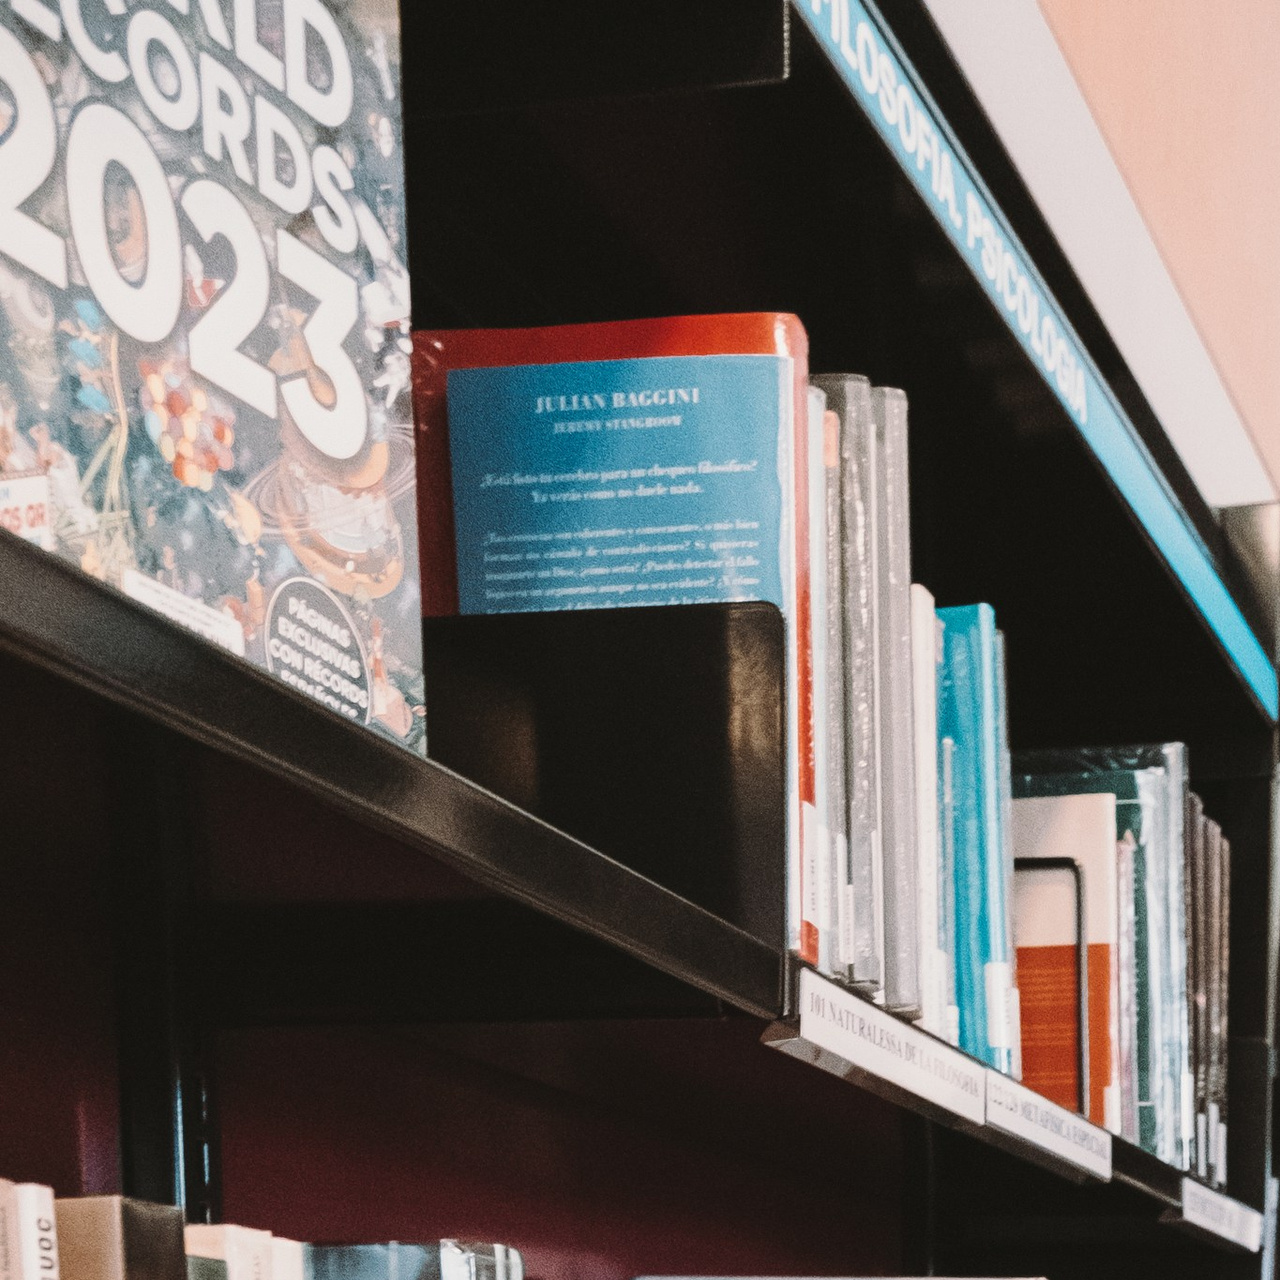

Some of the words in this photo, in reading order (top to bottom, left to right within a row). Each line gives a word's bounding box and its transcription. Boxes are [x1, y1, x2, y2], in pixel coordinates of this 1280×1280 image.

[0, 22, 367, 459] 2023
[966, 191, 1087, 424] PSICOLOGIA
[535, 393, 606, 415] JULIAN
[612, 387, 700, 409] BAGGINI
[277, 614, 362, 679] EXCLUSIVAS
[288, 596, 351, 648] PÁGINAS
[269, 637, 305, 674] CON
[301, 653, 370, 709] RÉCORDS
[809, 991, 827, 1017] 101
[828, 1001, 902, 1059] NATURALESSA
[38, 1216, 56, 1271] UOC
